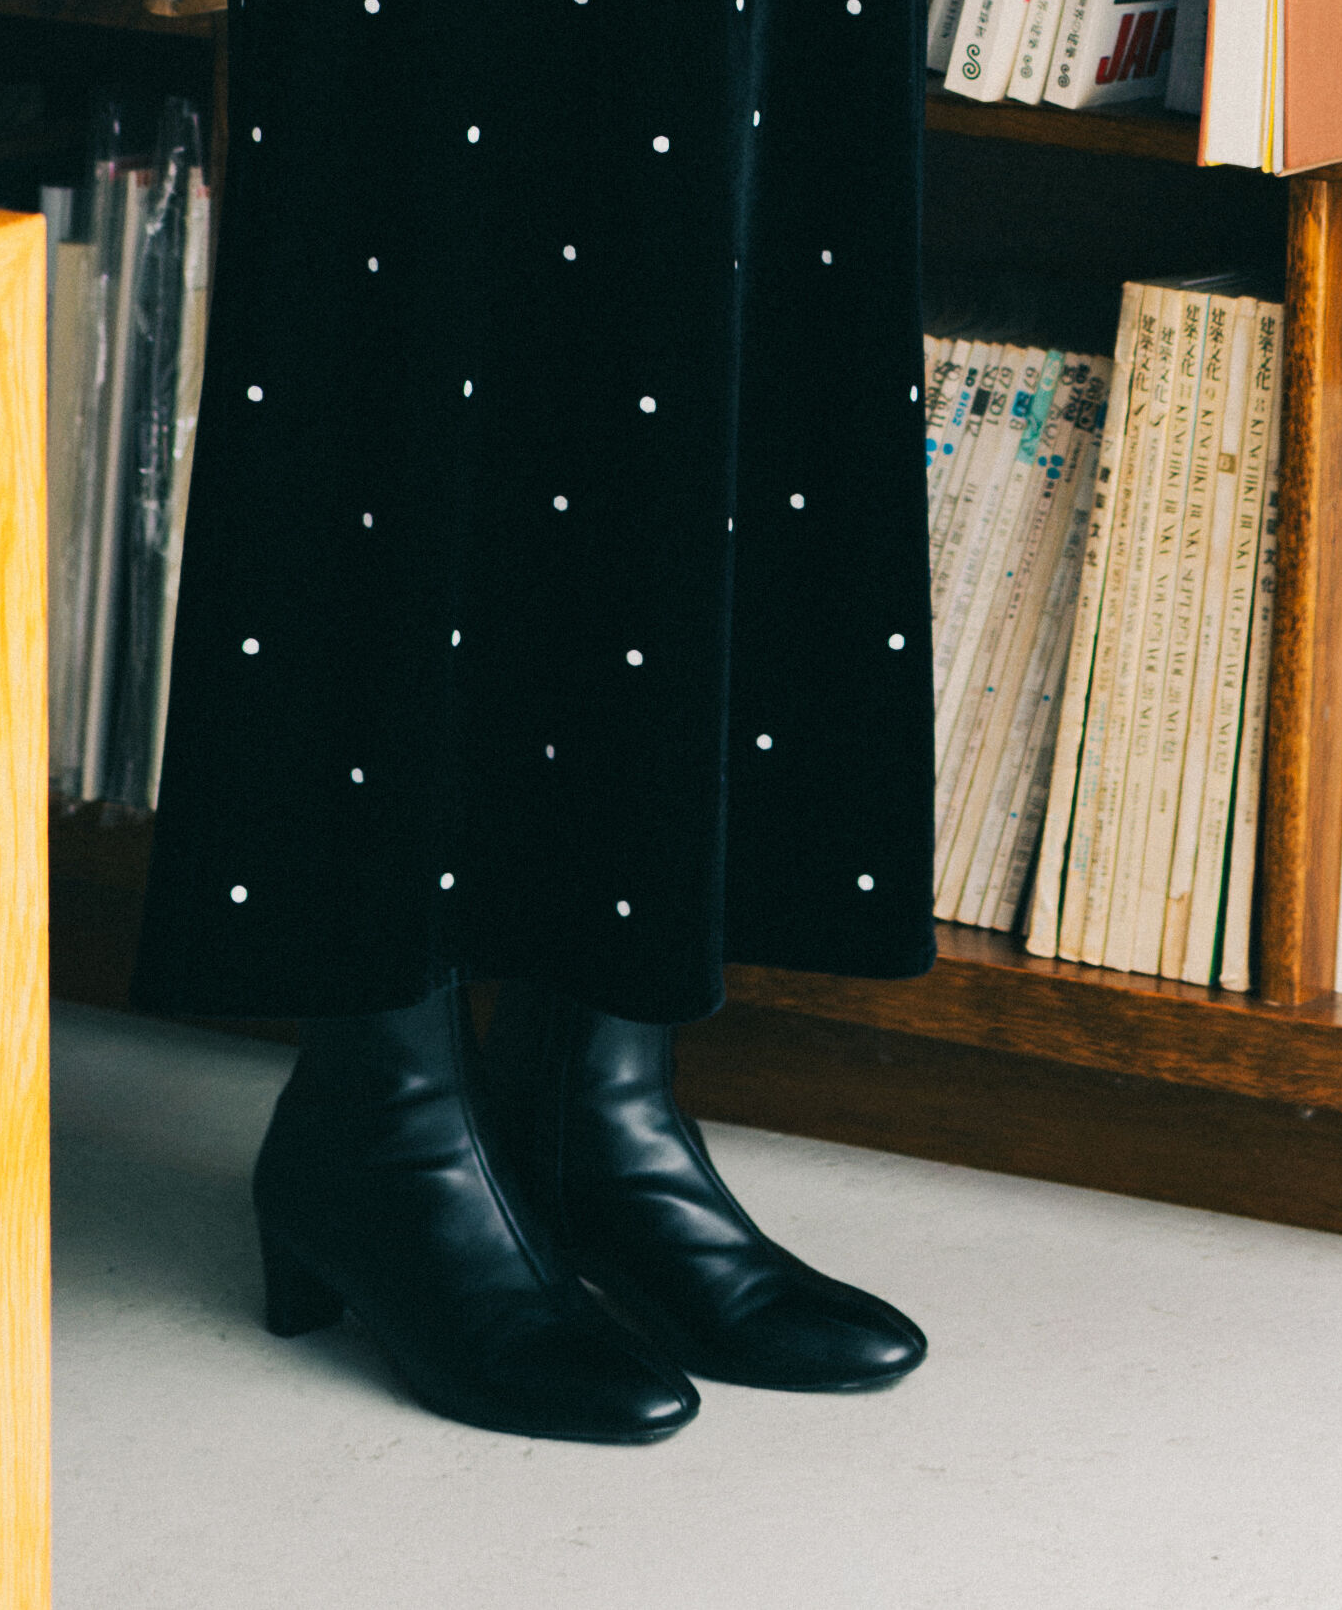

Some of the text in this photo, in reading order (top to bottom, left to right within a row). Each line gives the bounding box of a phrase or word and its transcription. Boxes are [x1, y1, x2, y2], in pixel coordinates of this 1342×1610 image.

[965, 367, 978, 387] SD
[1255, 315, 1277, 392] 建築文化
